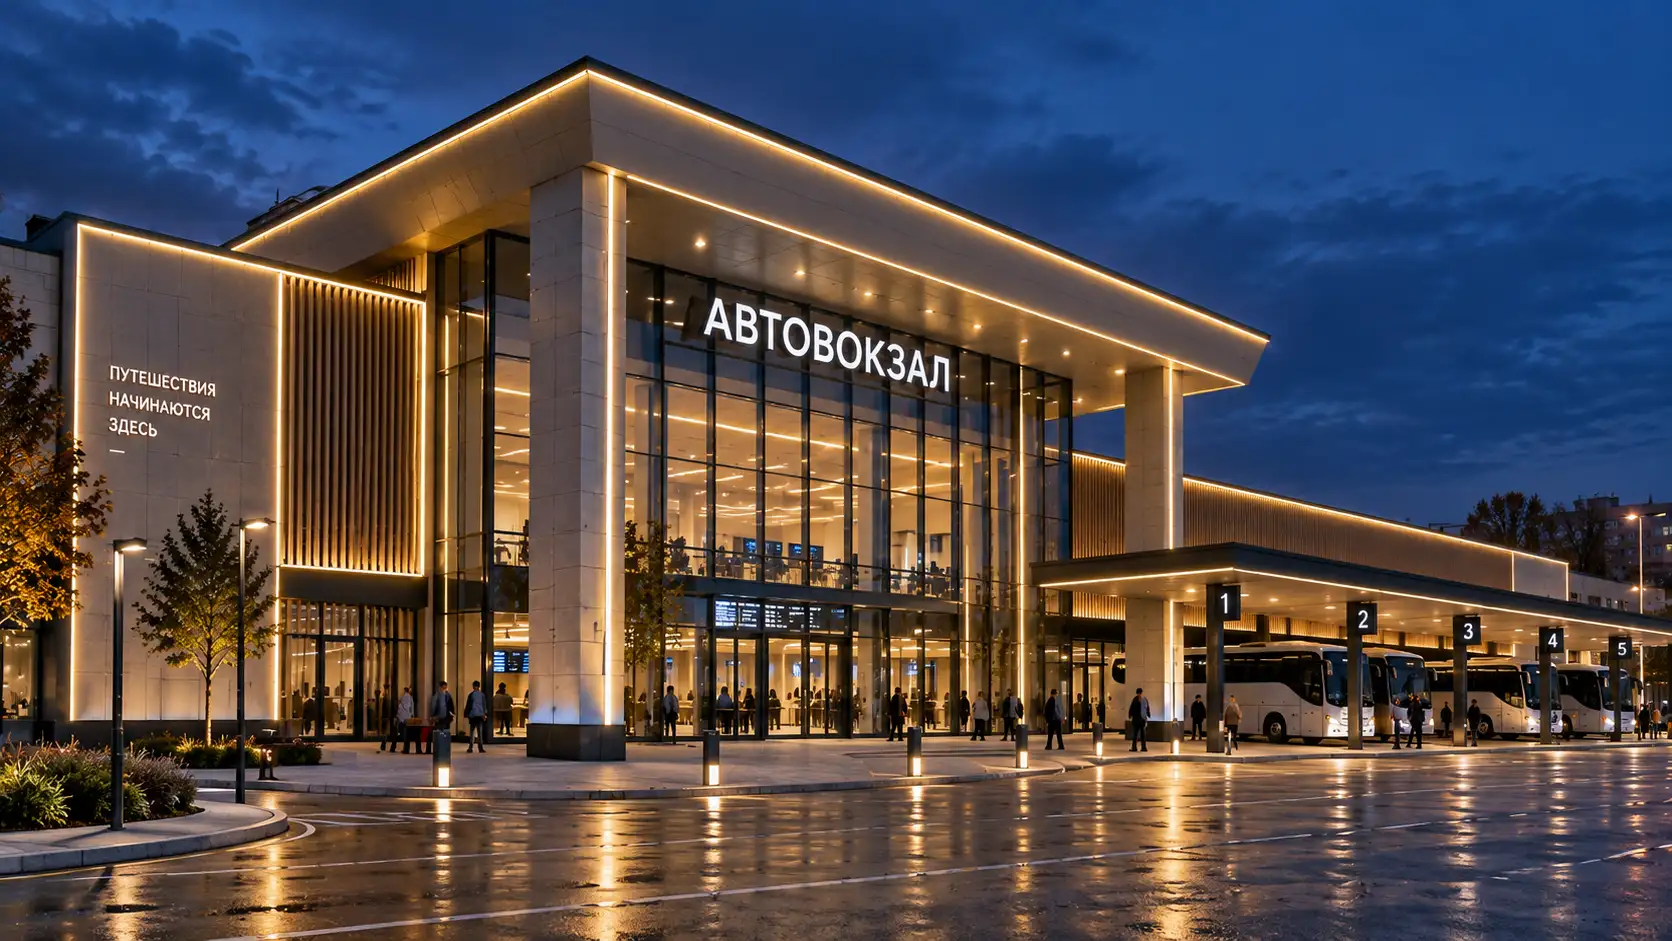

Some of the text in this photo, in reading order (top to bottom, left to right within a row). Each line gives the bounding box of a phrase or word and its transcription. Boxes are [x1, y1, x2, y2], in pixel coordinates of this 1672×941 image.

[703, 297, 950, 392] АВТОВОКЗАЛ
[109, 365, 216, 398] ПУТЕШЕСТВИЯ
[109, 391, 211, 421] НАЧИНАЮТСЯ
[108, 417, 158, 437] ЗДЕСЬ
[1220, 592, 1228, 614] 1
[1357, 609, 1369, 629] 2
[1463, 622, 1475, 640] 3
[1547, 633, 1558, 648] 4
[1617, 642, 1627, 656] 5
